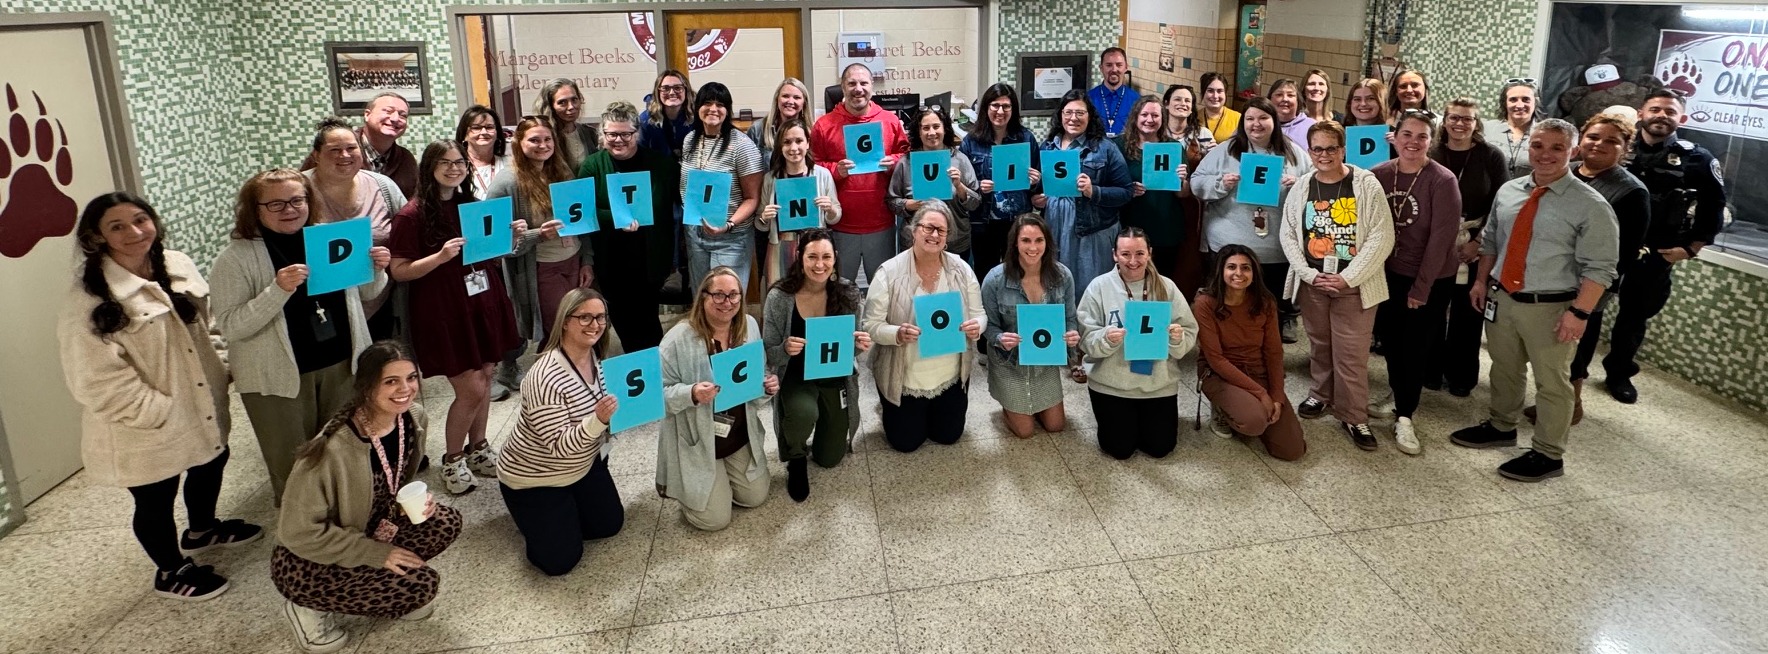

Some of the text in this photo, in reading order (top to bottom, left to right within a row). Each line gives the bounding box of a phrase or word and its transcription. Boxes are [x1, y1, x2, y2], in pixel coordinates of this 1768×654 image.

[912, 41, 961, 57] Beeks
[1722, 40, 1768, 71] ON
[490, 48, 635, 71] Margaret Beeks
[687, 52, 711, 69] 962
[509, 74, 619, 90] Elentary
[1713, 112, 1766, 129] CLEAR EYES.
[857, 134, 873, 153] G
[1359, 137, 1376, 156] D
[923, 163, 939, 182] U
[1007, 163, 1016, 181] I
[1054, 161, 1068, 179] S
[1154, 154, 1170, 172] H
[1253, 166, 1269, 185] E
[621, 185, 637, 204] T
[703, 184, 713, 203] I
[569, 203, 583, 223] S
[789, 199, 808, 219] N
[483, 215, 493, 237] I
[1325, 224, 1354, 235] Kind
[328, 238, 353, 265] D
[930, 309, 950, 330] O
[1140, 315, 1154, 334] L
[1032, 328, 1052, 349] O
[820, 341, 840, 365] H
[731, 360, 748, 384] C
[626, 368, 646, 398] S
